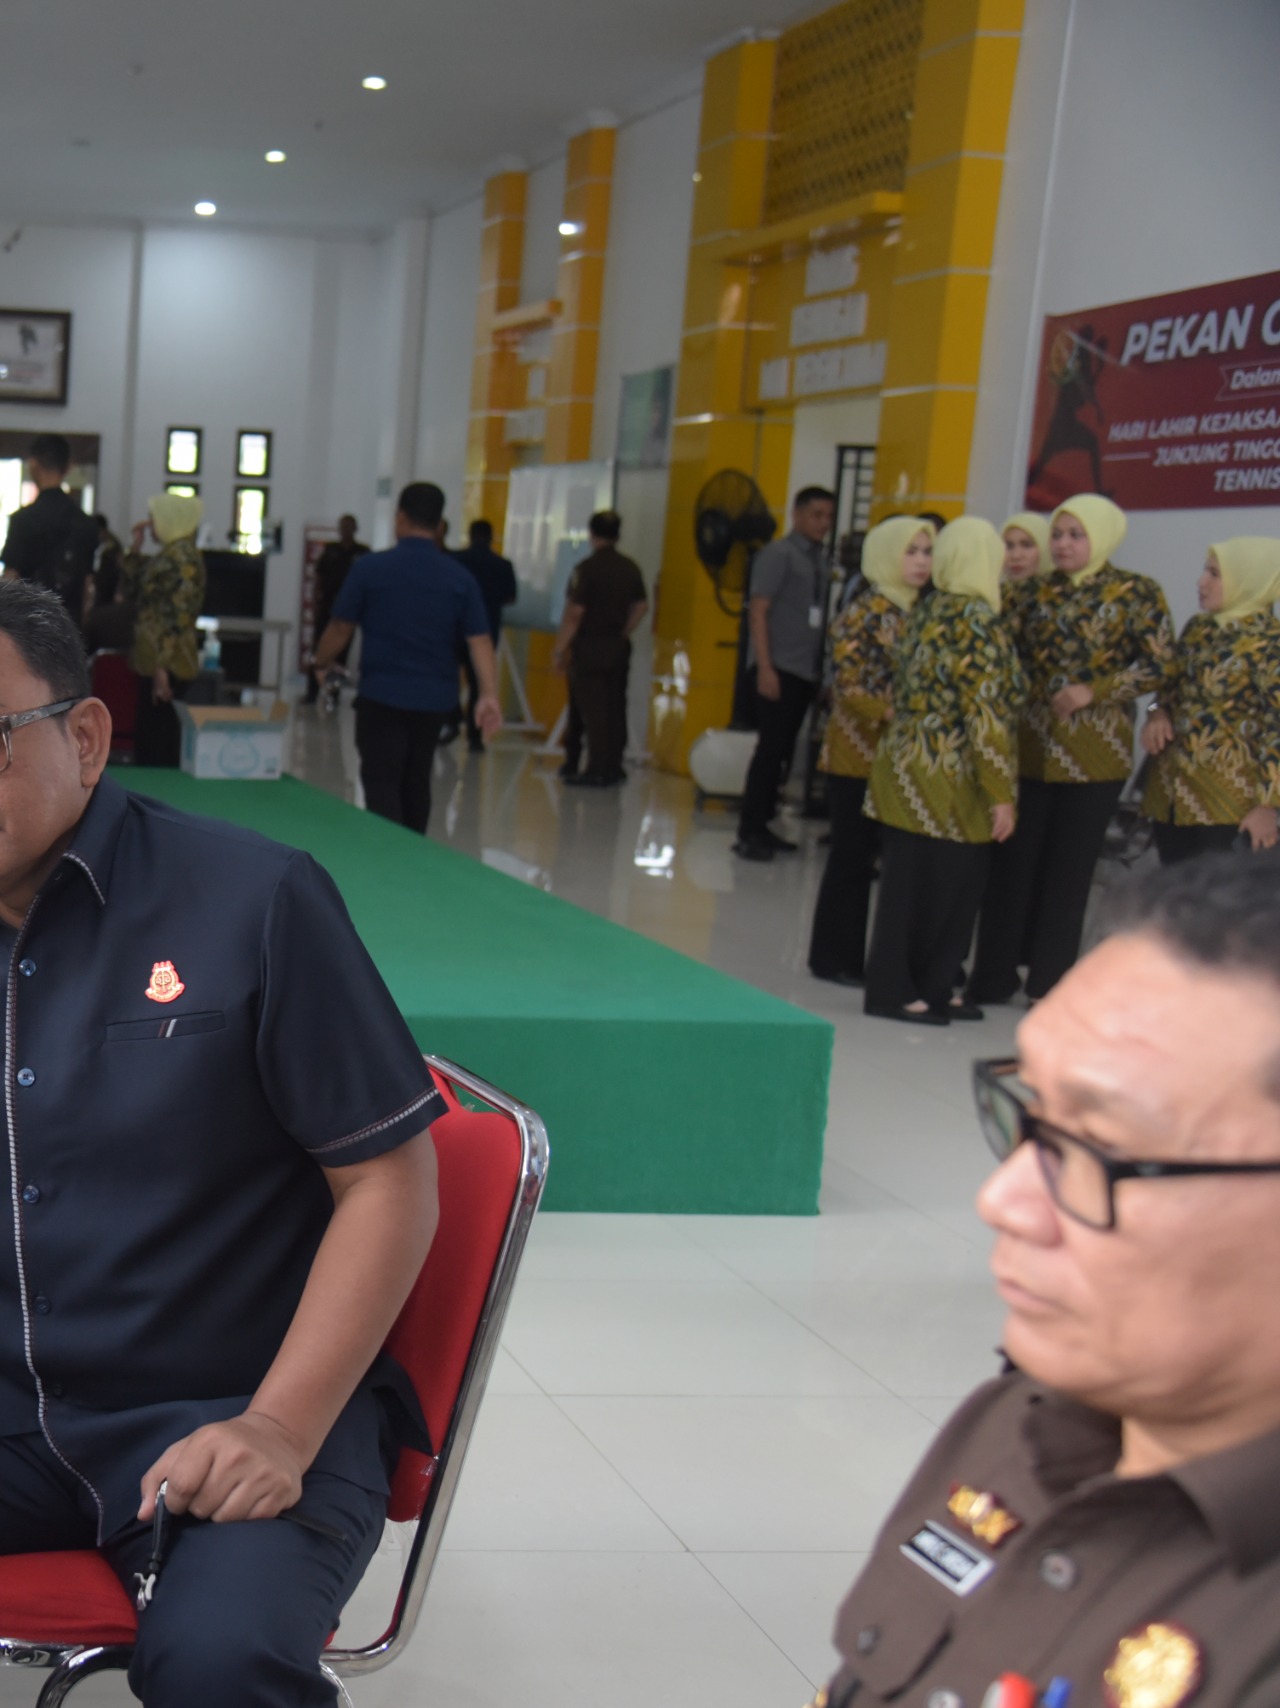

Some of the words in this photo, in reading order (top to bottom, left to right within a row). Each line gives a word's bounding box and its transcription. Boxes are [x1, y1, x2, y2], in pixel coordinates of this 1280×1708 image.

[1120, 304, 1254, 367] PEKAN
[1108, 423, 1145, 442] HARI
[1149, 417, 1196, 440] LAHIR
[1153, 443, 1229, 467] JUNJUNG
